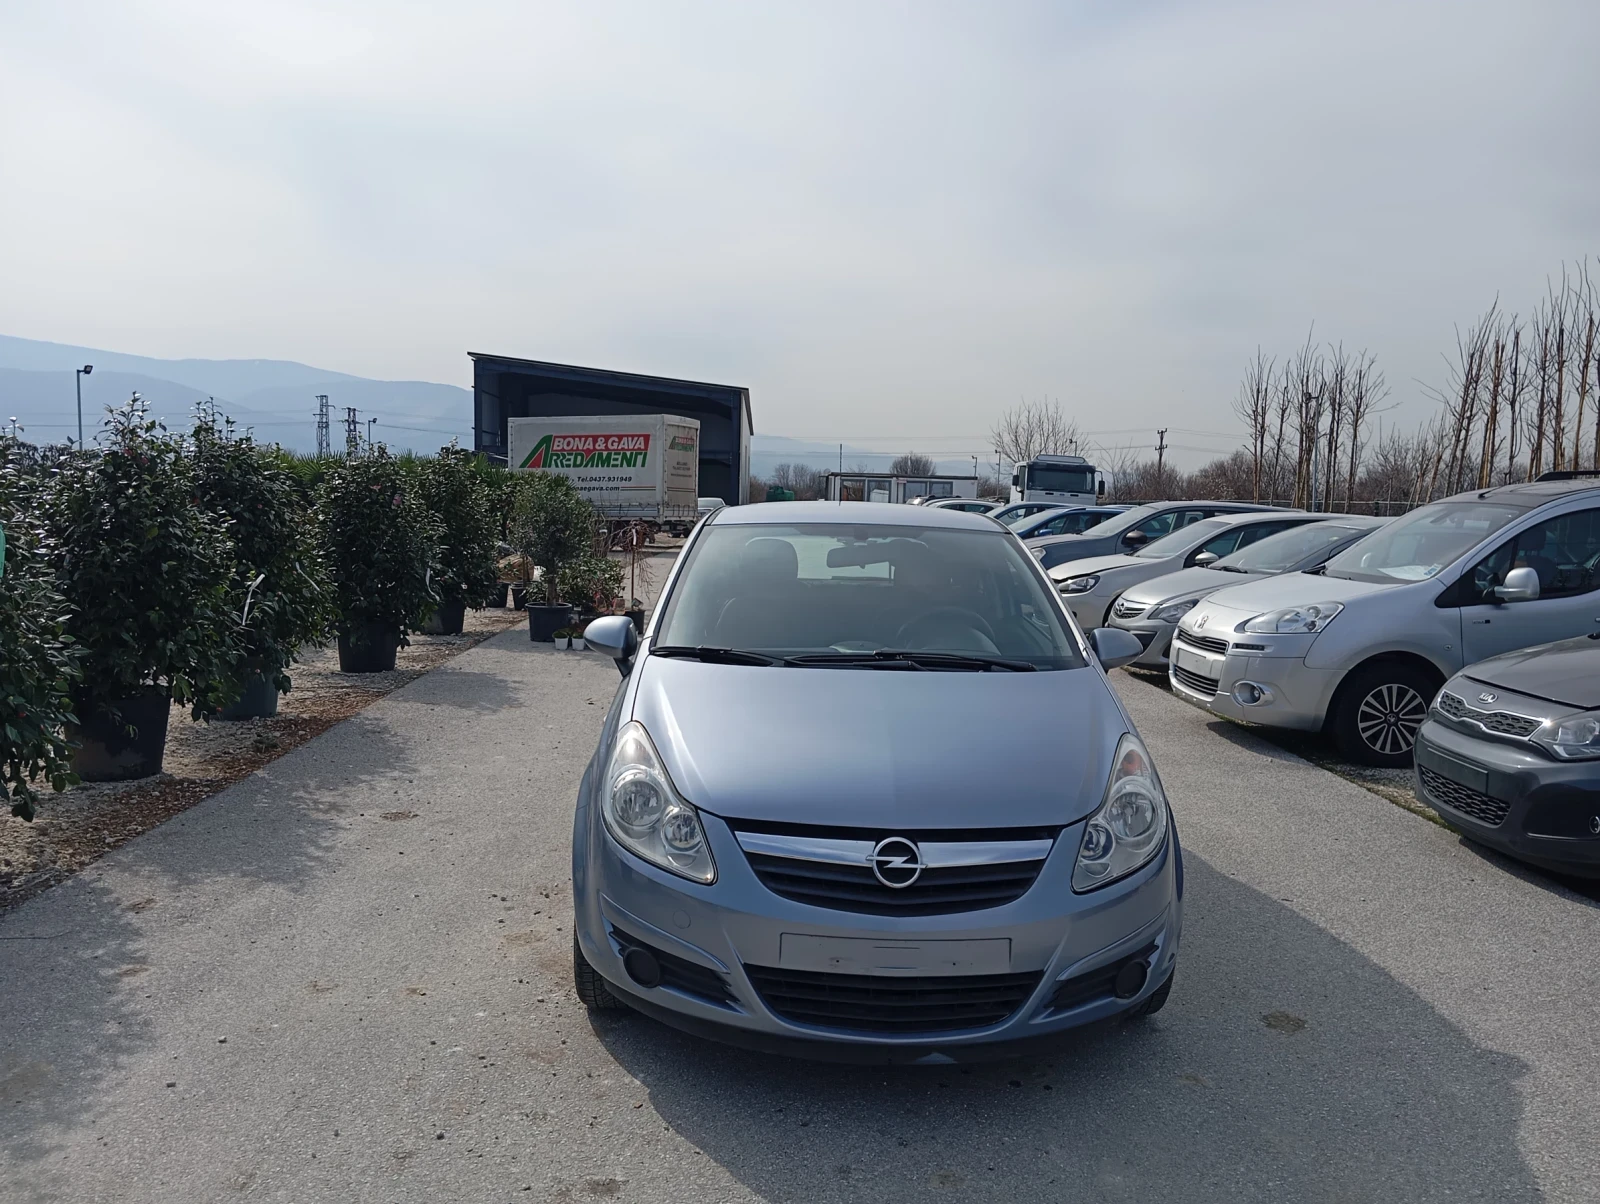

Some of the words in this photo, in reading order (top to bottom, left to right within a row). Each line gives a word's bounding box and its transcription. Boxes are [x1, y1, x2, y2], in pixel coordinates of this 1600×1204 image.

[518, 434, 648, 468] ARREDAMENTI
[553, 437, 593, 450] BONA
[595, 437, 606, 450] &
[608, 436, 645, 450] GAVA
